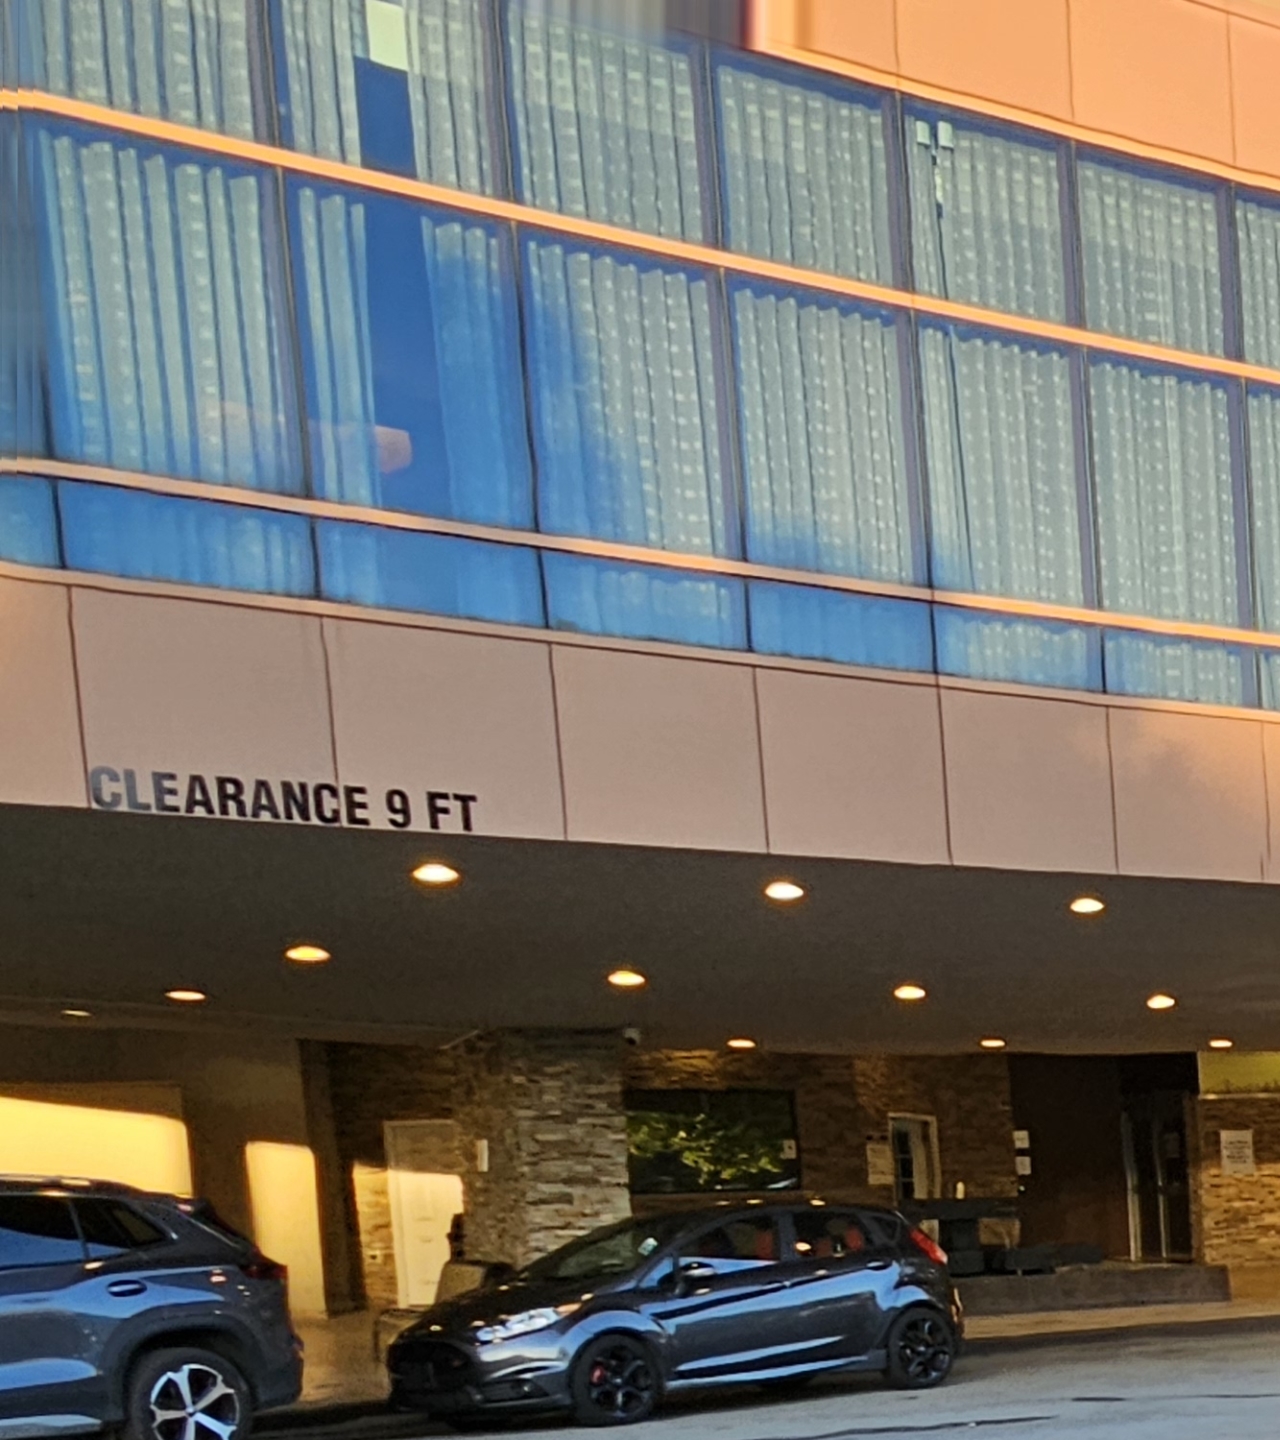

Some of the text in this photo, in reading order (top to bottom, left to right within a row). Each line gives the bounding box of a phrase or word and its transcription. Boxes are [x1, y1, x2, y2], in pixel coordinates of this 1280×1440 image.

[90, 765, 478, 832] CLEARANCE 9 FT
